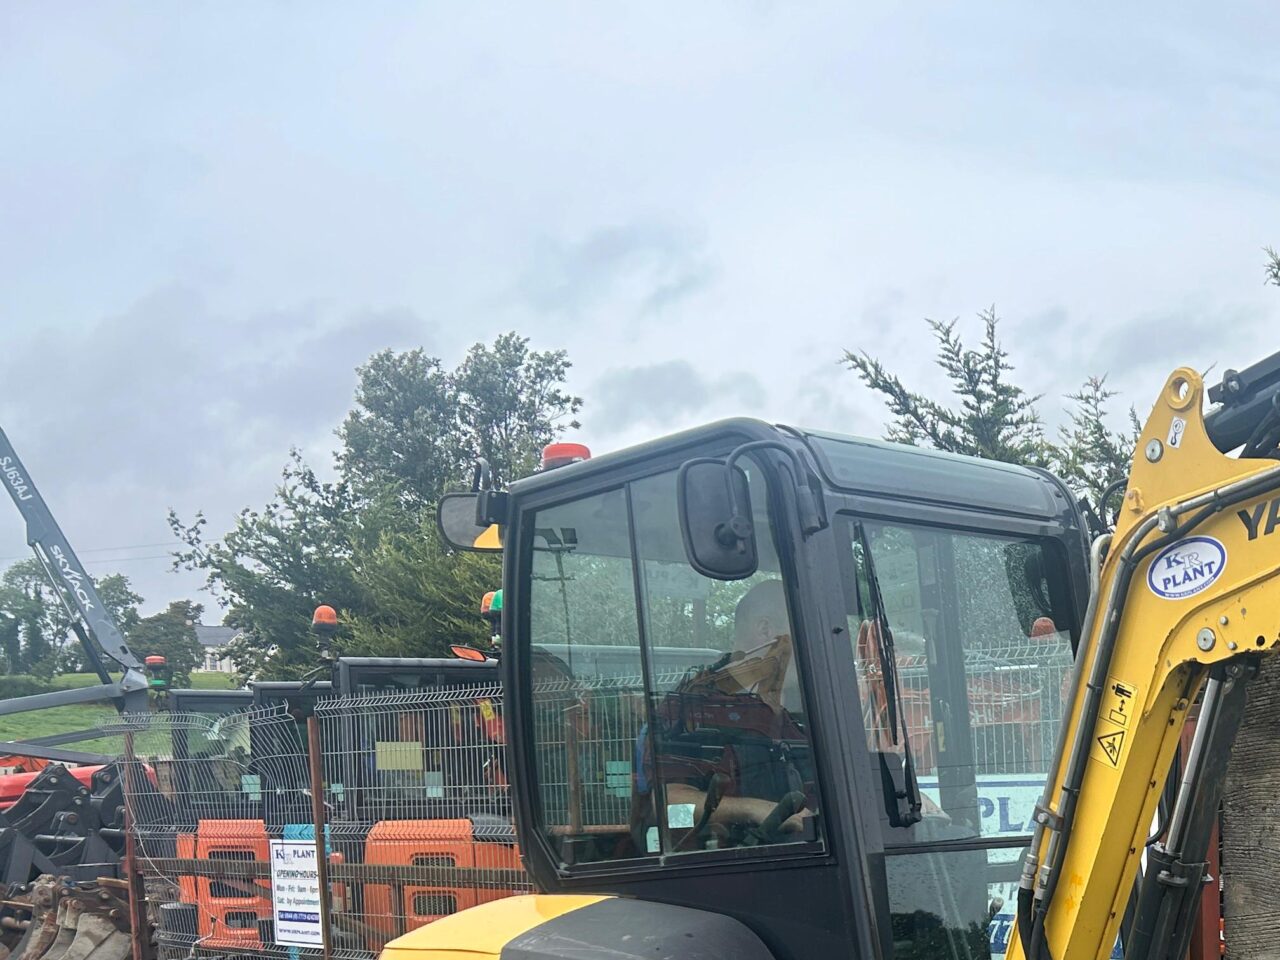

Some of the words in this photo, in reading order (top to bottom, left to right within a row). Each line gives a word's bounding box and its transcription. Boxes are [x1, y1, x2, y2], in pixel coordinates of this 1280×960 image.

[0, 456, 33, 501] SJ63AJ
[50, 544, 95, 612] SKYJACK
[1162, 561, 1216, 591] PLANT
[293, 850, 316, 859] PLANT
